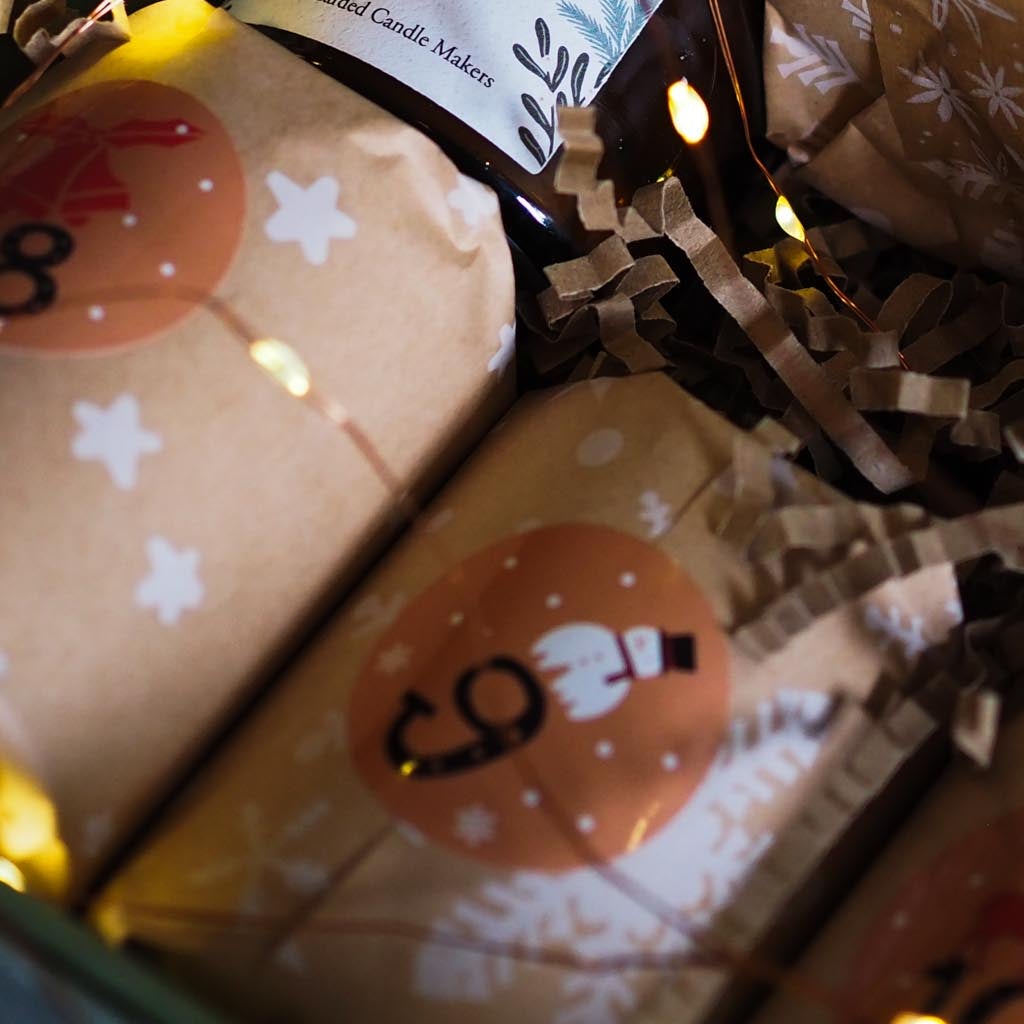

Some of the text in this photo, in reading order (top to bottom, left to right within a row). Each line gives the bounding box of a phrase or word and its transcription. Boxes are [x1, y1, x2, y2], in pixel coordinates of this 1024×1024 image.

[371, 7, 431, 47] Candle
[430, 38, 496, 89] Makers
[0, 222, 75, 317] 8
